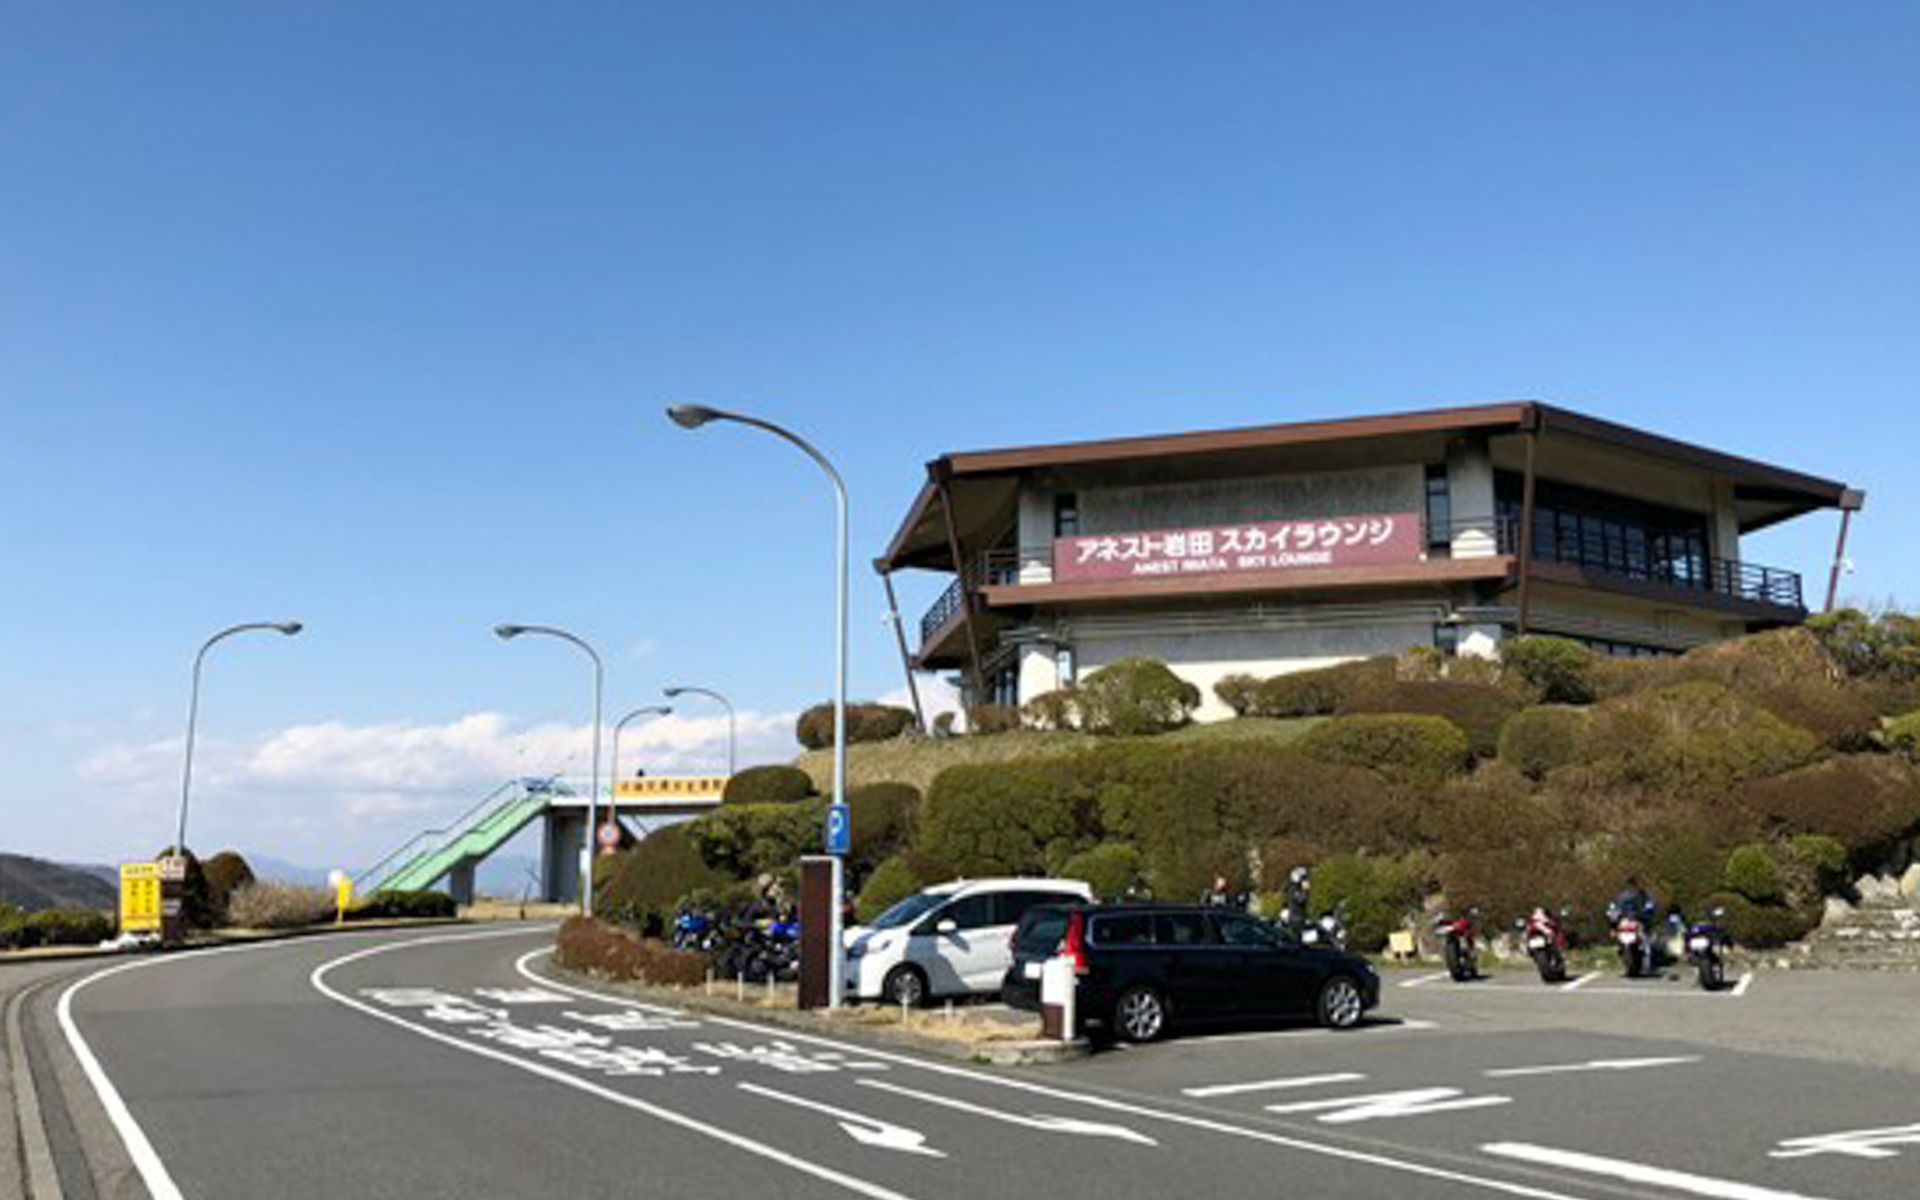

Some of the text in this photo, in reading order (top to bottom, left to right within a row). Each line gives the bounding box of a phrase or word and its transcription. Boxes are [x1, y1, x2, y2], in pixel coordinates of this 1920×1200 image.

[1075, 516, 1394, 564] アネスト岩田 スカイラウンジ
